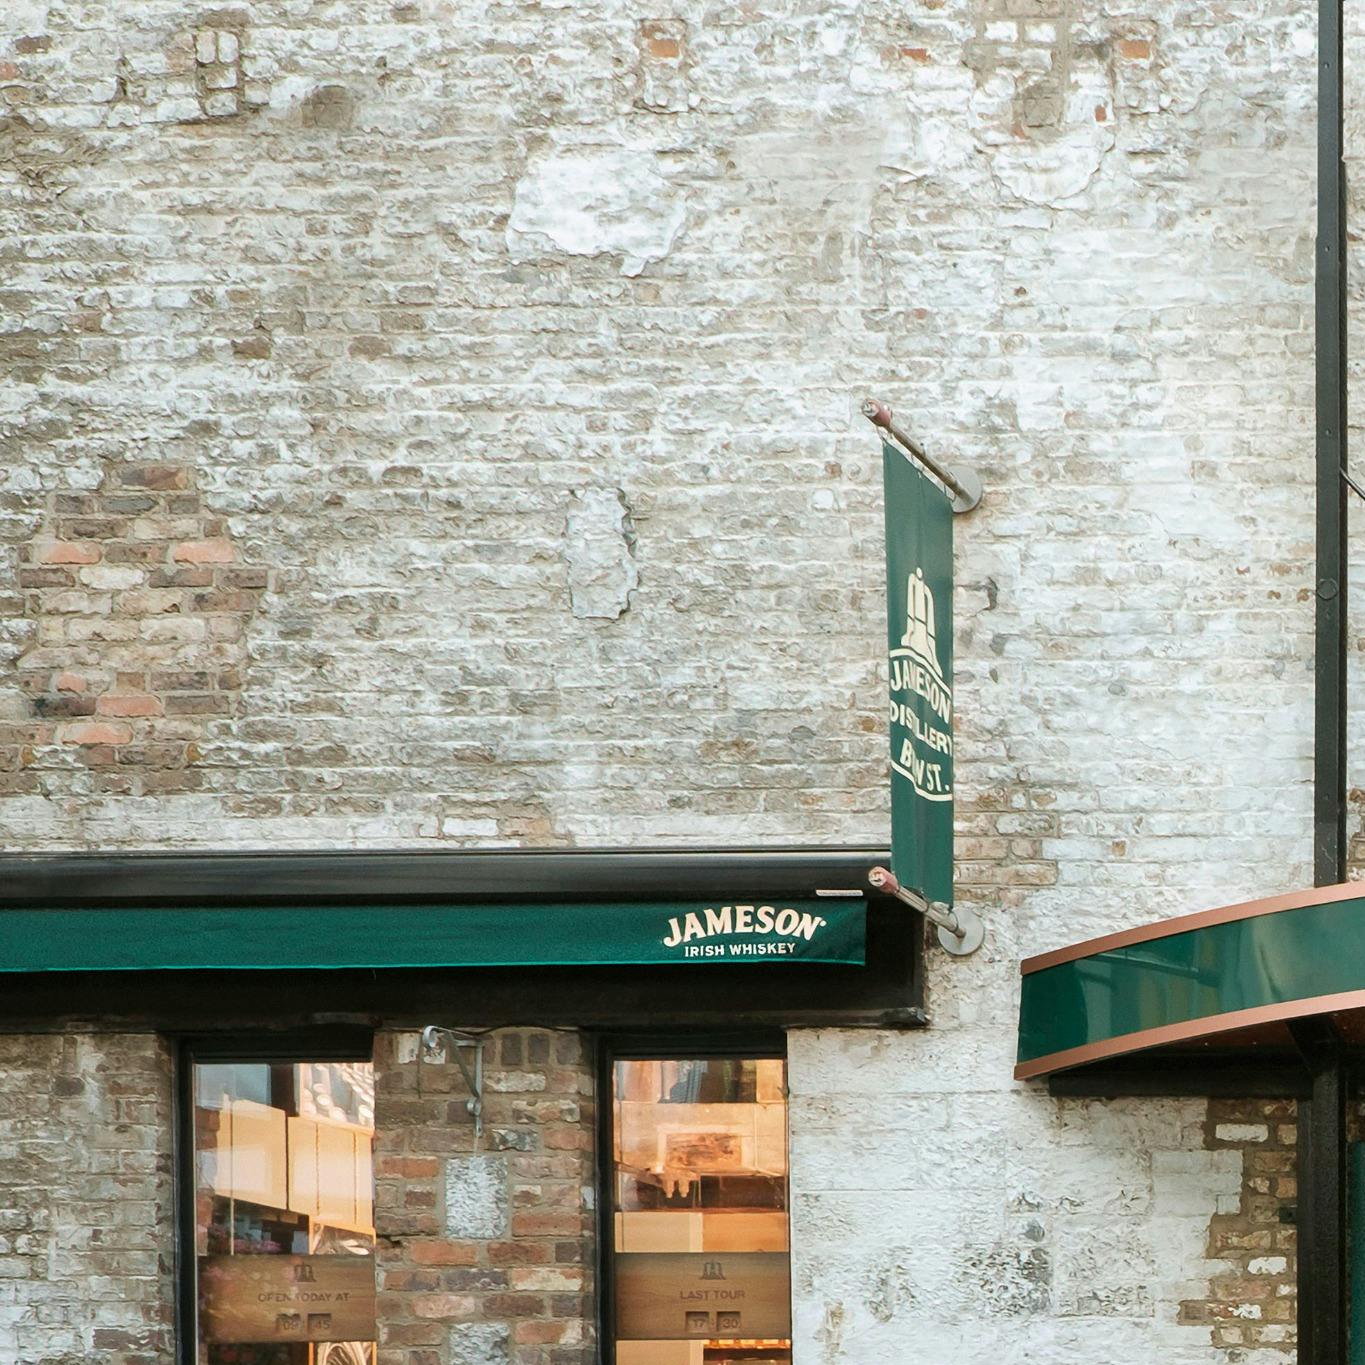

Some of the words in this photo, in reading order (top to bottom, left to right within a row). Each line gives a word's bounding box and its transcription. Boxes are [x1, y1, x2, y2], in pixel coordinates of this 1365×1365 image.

[900, 737, 925, 785] BW
[663, 905, 823, 947] JAMESON
[684, 944, 725, 958] IRISH
[729, 942, 796, 956] WHISKEY
[257, 1292, 291, 1302] OPEN
[335, 1292, 351, 1302] AT
[680, 1289, 711, 1301] LAST
[714, 1289, 746, 1300] TOUR
